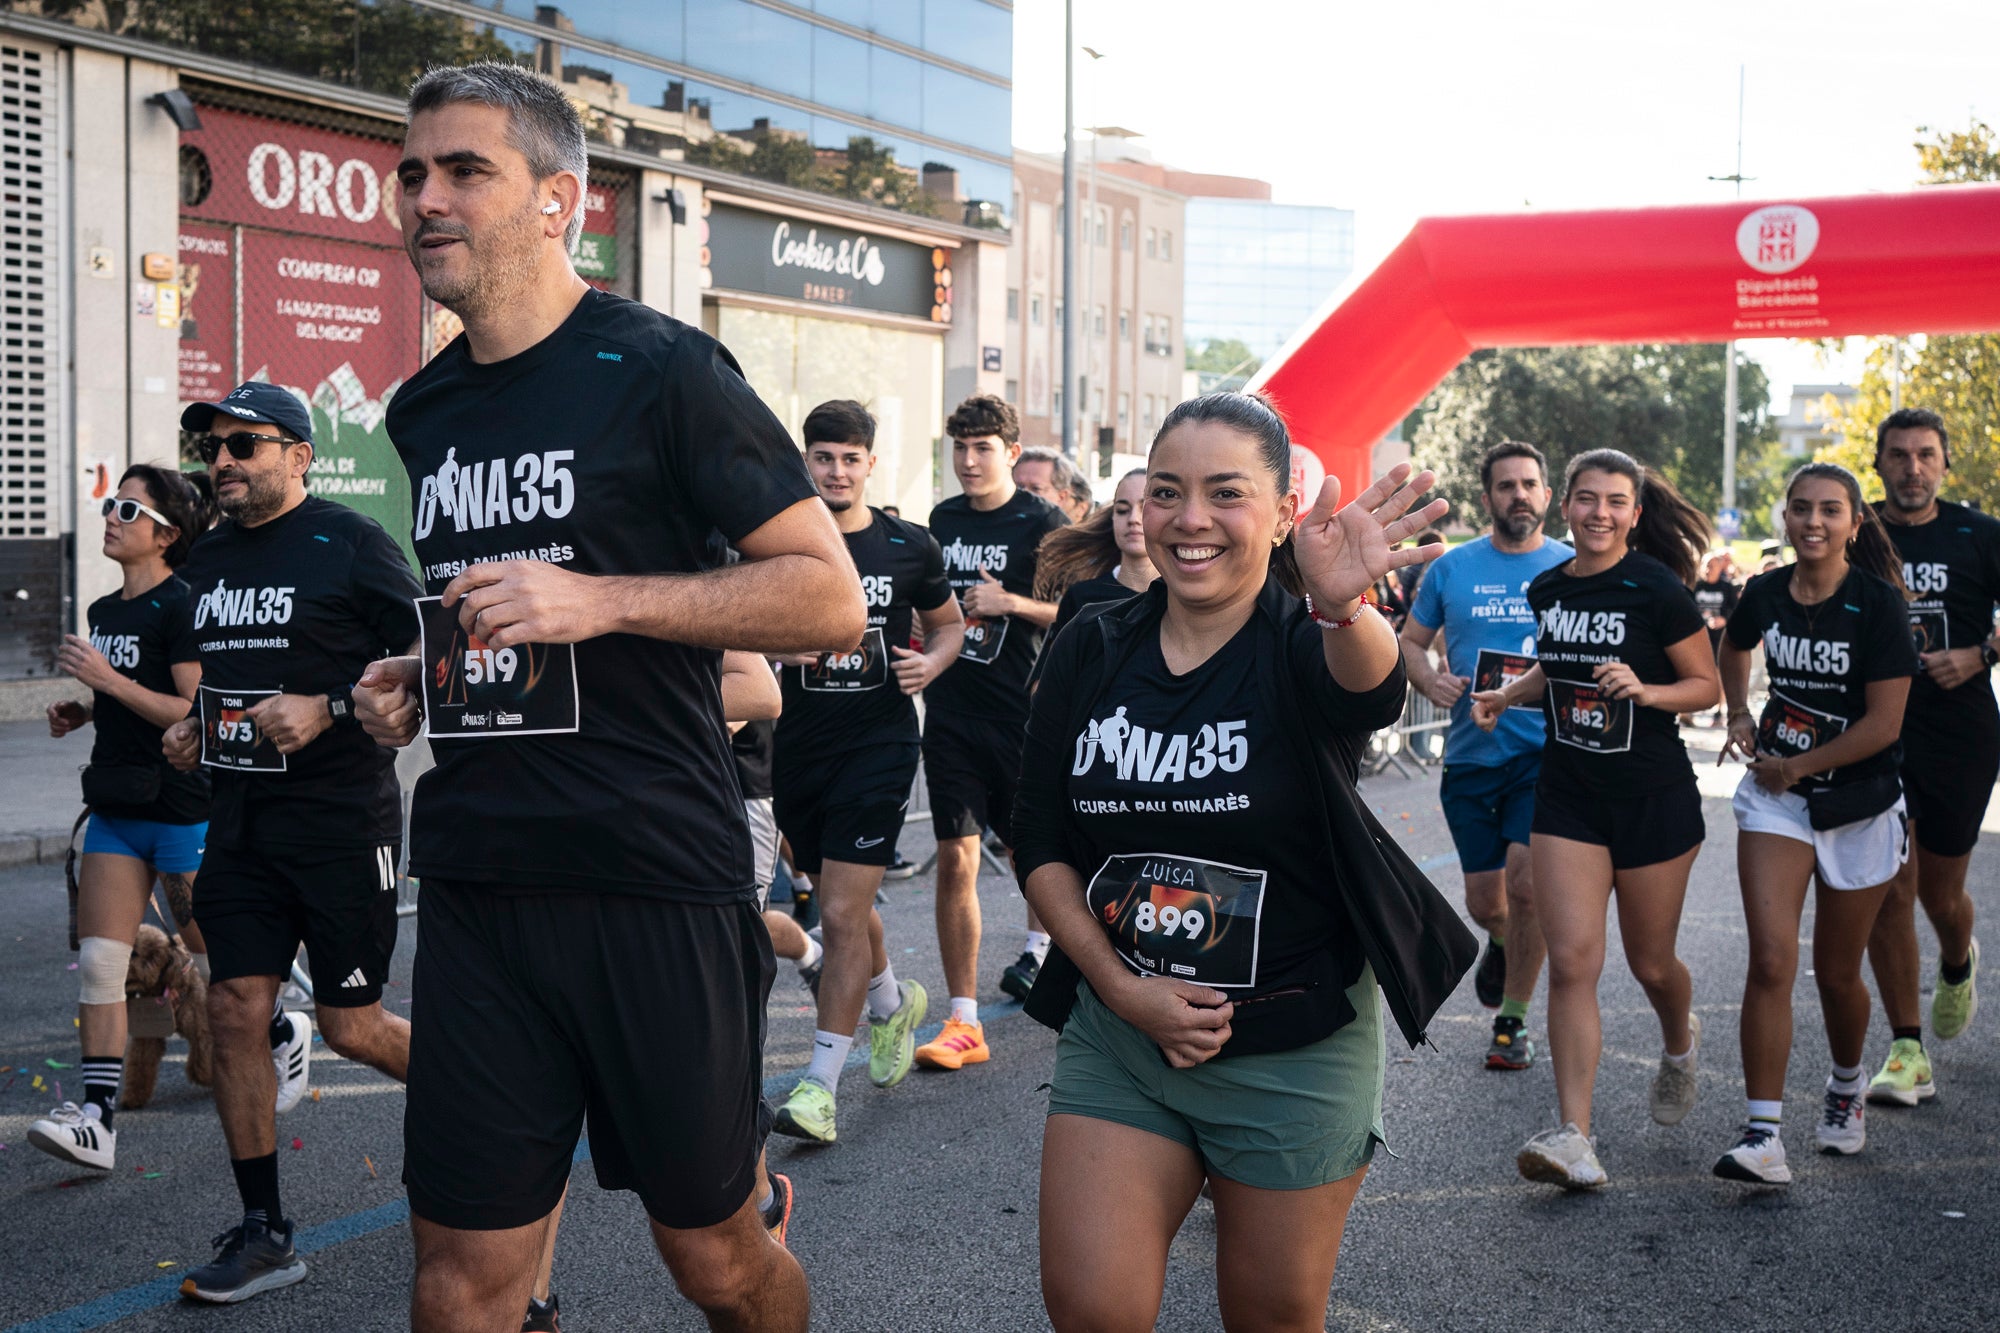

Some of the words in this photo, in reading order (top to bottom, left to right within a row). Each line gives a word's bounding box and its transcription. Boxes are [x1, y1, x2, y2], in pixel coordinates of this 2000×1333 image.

[277, 257, 355, 286] COMPREM
[356, 267, 381, 288] OR
[1736, 275, 1819, 294] Diputació
[1737, 293, 1819, 308] Barcelona
[337, 457, 356, 475] DE
[1471, 605, 1506, 617] FESTA
[965, 626, 984, 642] 48
[202, 640, 227, 652] CURSA
[228, 639, 245, 650] PAU
[247, 636, 290, 649] DINARÈS
[464, 647, 518, 685] 519
[825, 654, 864, 671] 449
[1561, 652, 1578, 663] PAU
[221, 697, 243, 708] TONI
[1572, 707, 1604, 729] 882
[217, 720, 253, 743] 673
[1776, 722, 1811, 750] 880
[1079, 800, 1131, 814] CURSA
[1134, 801, 1167, 812] PAU
[1172, 792, 1250, 814] DINARÈS
[1135, 901, 1205, 940] 899
